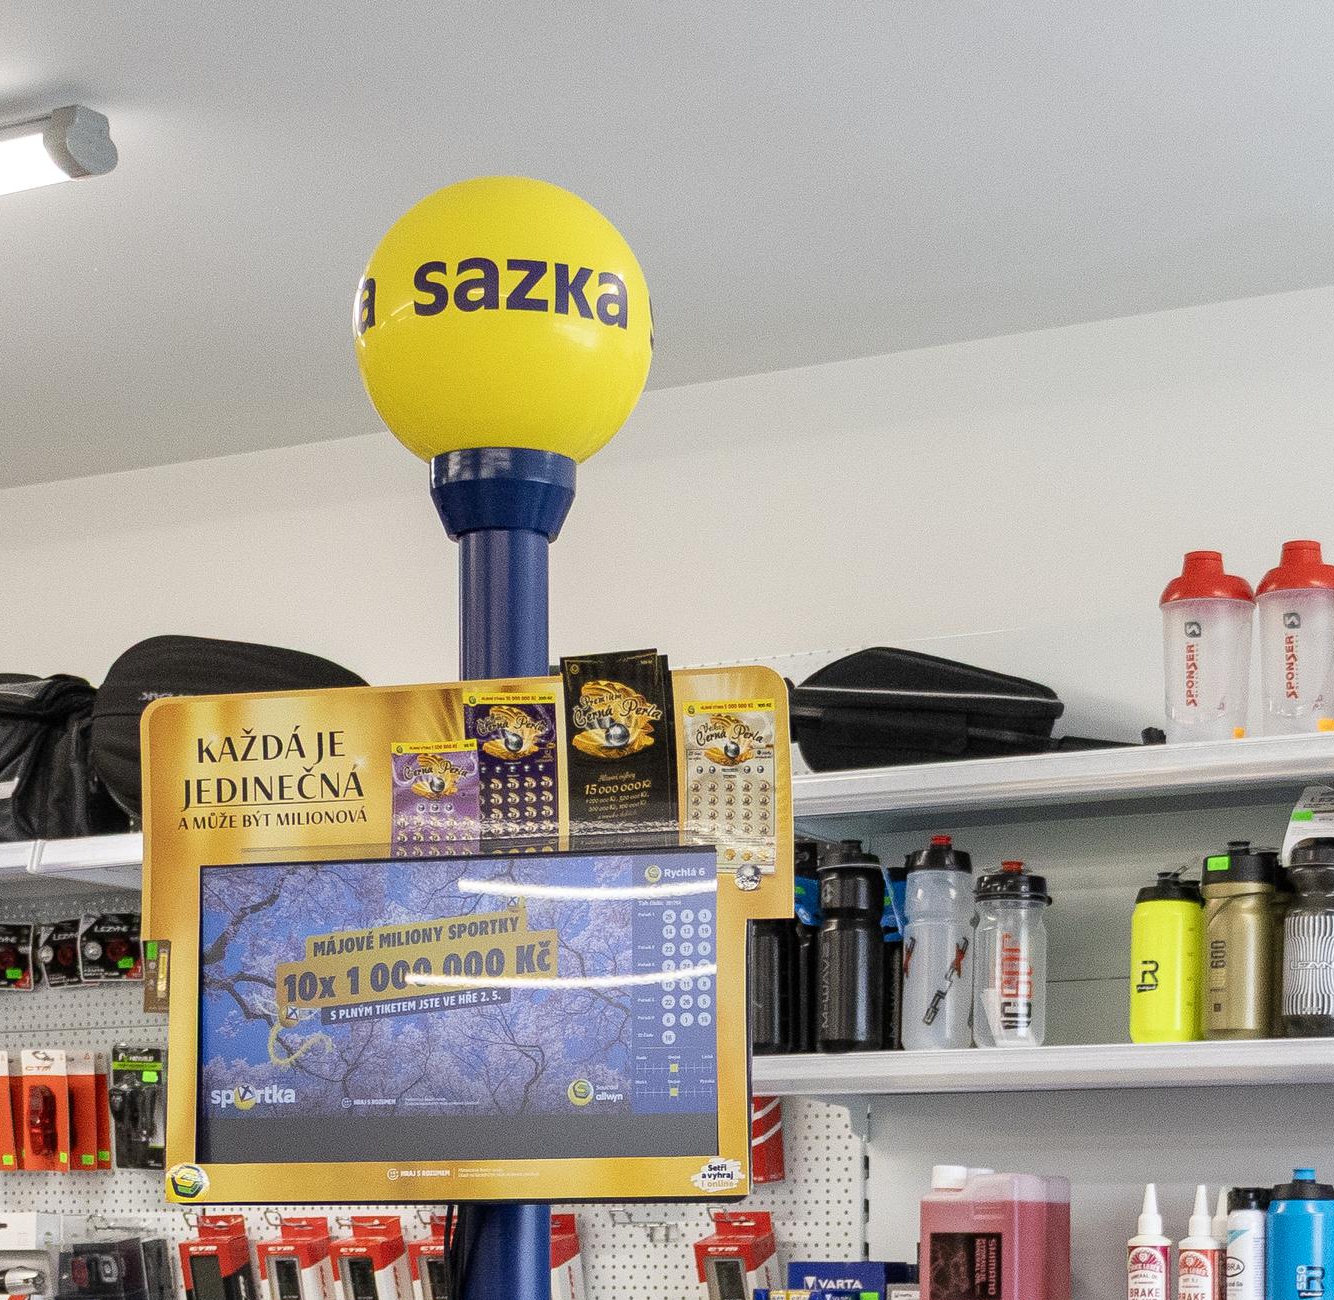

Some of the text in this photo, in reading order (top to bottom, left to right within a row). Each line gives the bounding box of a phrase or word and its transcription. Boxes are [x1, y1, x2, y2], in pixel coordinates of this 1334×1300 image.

[413, 257, 628, 330] sazka
[1186, 642, 1198, 707] SPONSER
[1285, 633, 1298, 699] SPONSER
[573, 697, 662, 728] Černá Perla
[197, 725, 345, 766] KAŽDÁ JE
[732, 723, 764, 744] Perla
[180, 763, 364, 812] JEDINEČNÁ
[598, 781, 641, 794] 000 000
[178, 805, 367, 830] A MŮŽE BÝT MILIONOVÁ
[664, 868, 706, 880] Rychlá 6
[313, 916, 519, 957] MÁJOVÉ MILIONY SPORTKY
[284, 940, 551, 1003] 10x 1 000 Kč
[330, 991, 501, 1021] S PLNÝM TIKETEM JSTE VE HŘE 2. 5.
[596, 1092, 624, 1102] allwyn
[401, 1170, 416, 1178] HRAJ
[708, 1171, 734, 1180] vyhraj
[818, 1278, 863, 1290] VARTA
[1129, 1287, 1161, 1298] BRAKE
